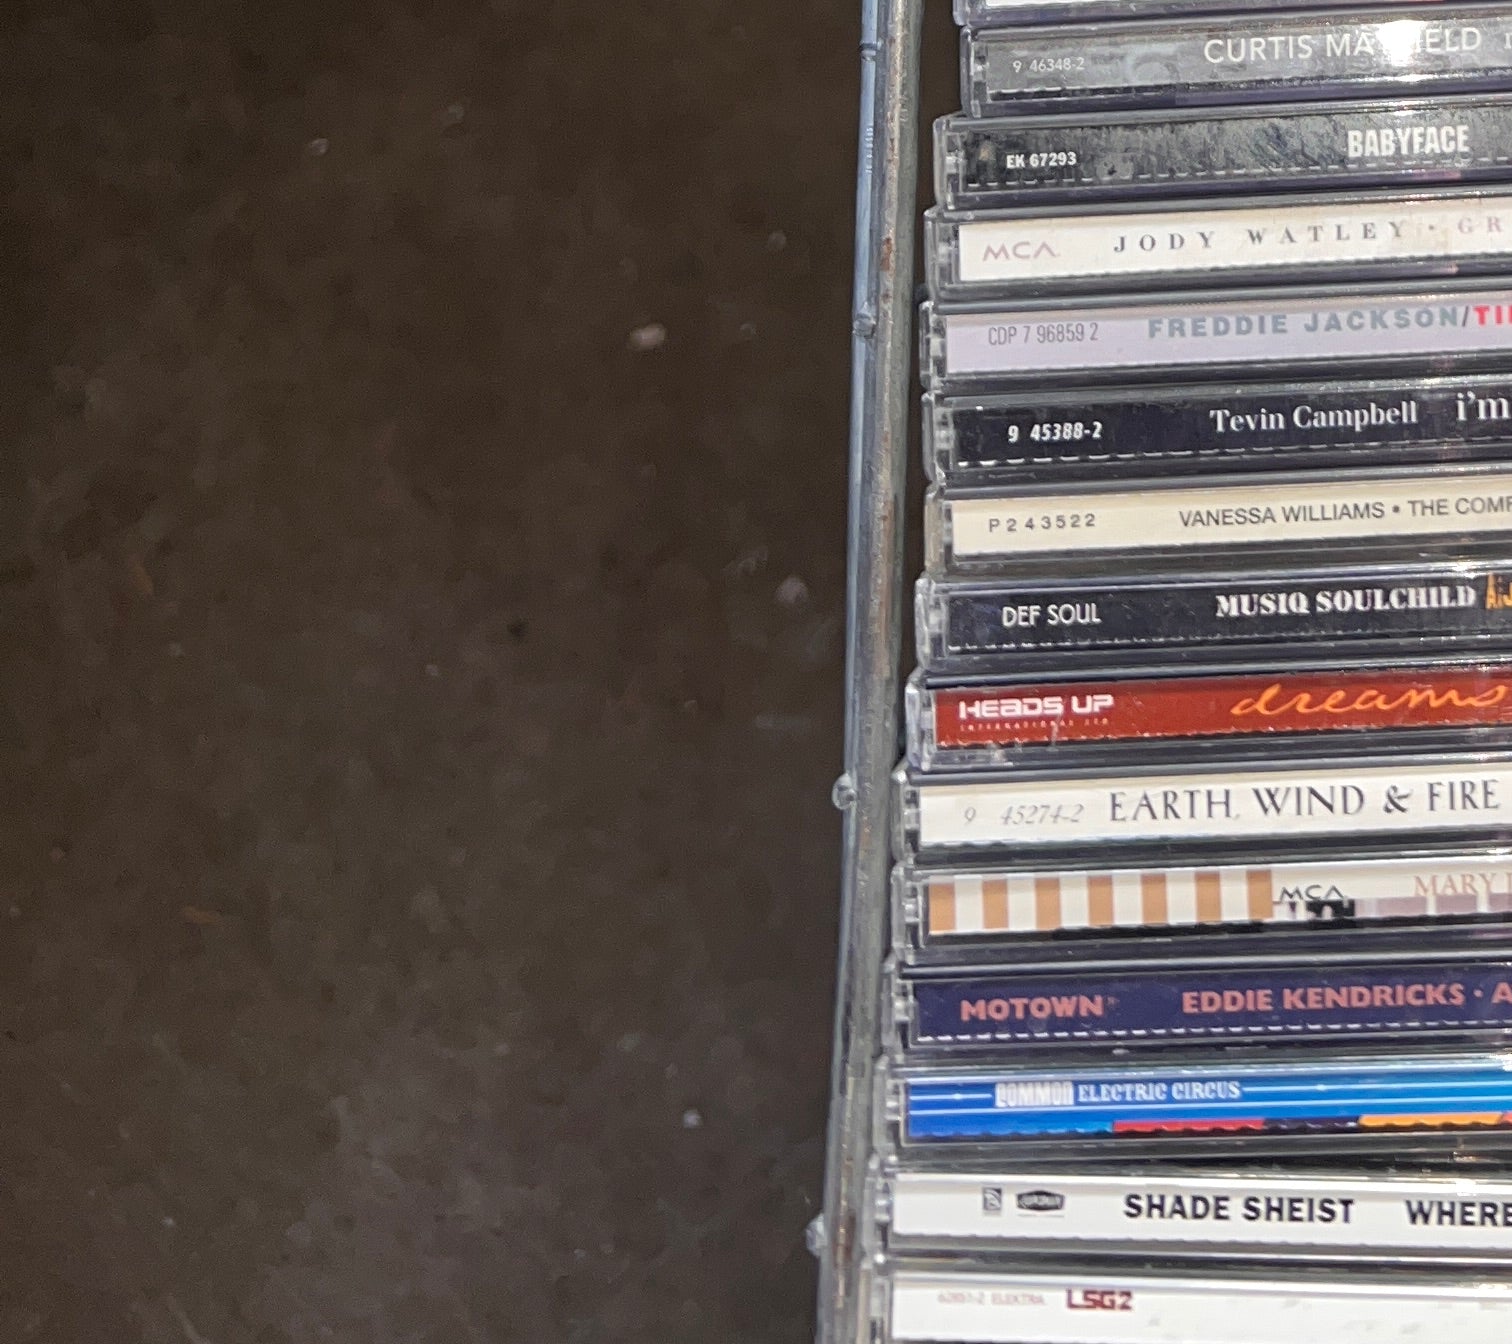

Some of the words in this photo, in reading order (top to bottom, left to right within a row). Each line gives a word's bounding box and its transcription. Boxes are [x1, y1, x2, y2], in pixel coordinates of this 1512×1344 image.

[1346, 123, 1471, 159] BABYFACE
[1006, 154, 1026, 168] EK
[1028, 151, 1077, 168] 67293
[1113, 230, 1214, 254] JODY
[1247, 220, 1404, 247] WATLEY
[1178, 508, 1276, 529] VANESSA
[1281, 501, 1385, 523] WILLIAMS
[1408, 494, 1449, 518] THE
[1002, 604, 1040, 629] DEF
[1047, 602, 1102, 626] SOUL
[1110, 790, 1241, 822] EARTH,
[1252, 785, 1365, 816] WIND
[1382, 789, 1413, 814] &
[1427, 778, 1500, 813] FIRE
[1182, 989, 1274, 1014] EDDIE
[1281, 981, 1465, 1011] KENDRICKS
[1123, 1194, 1231, 1221] SHADE
[1243, 1197, 1355, 1223] SHEIST
